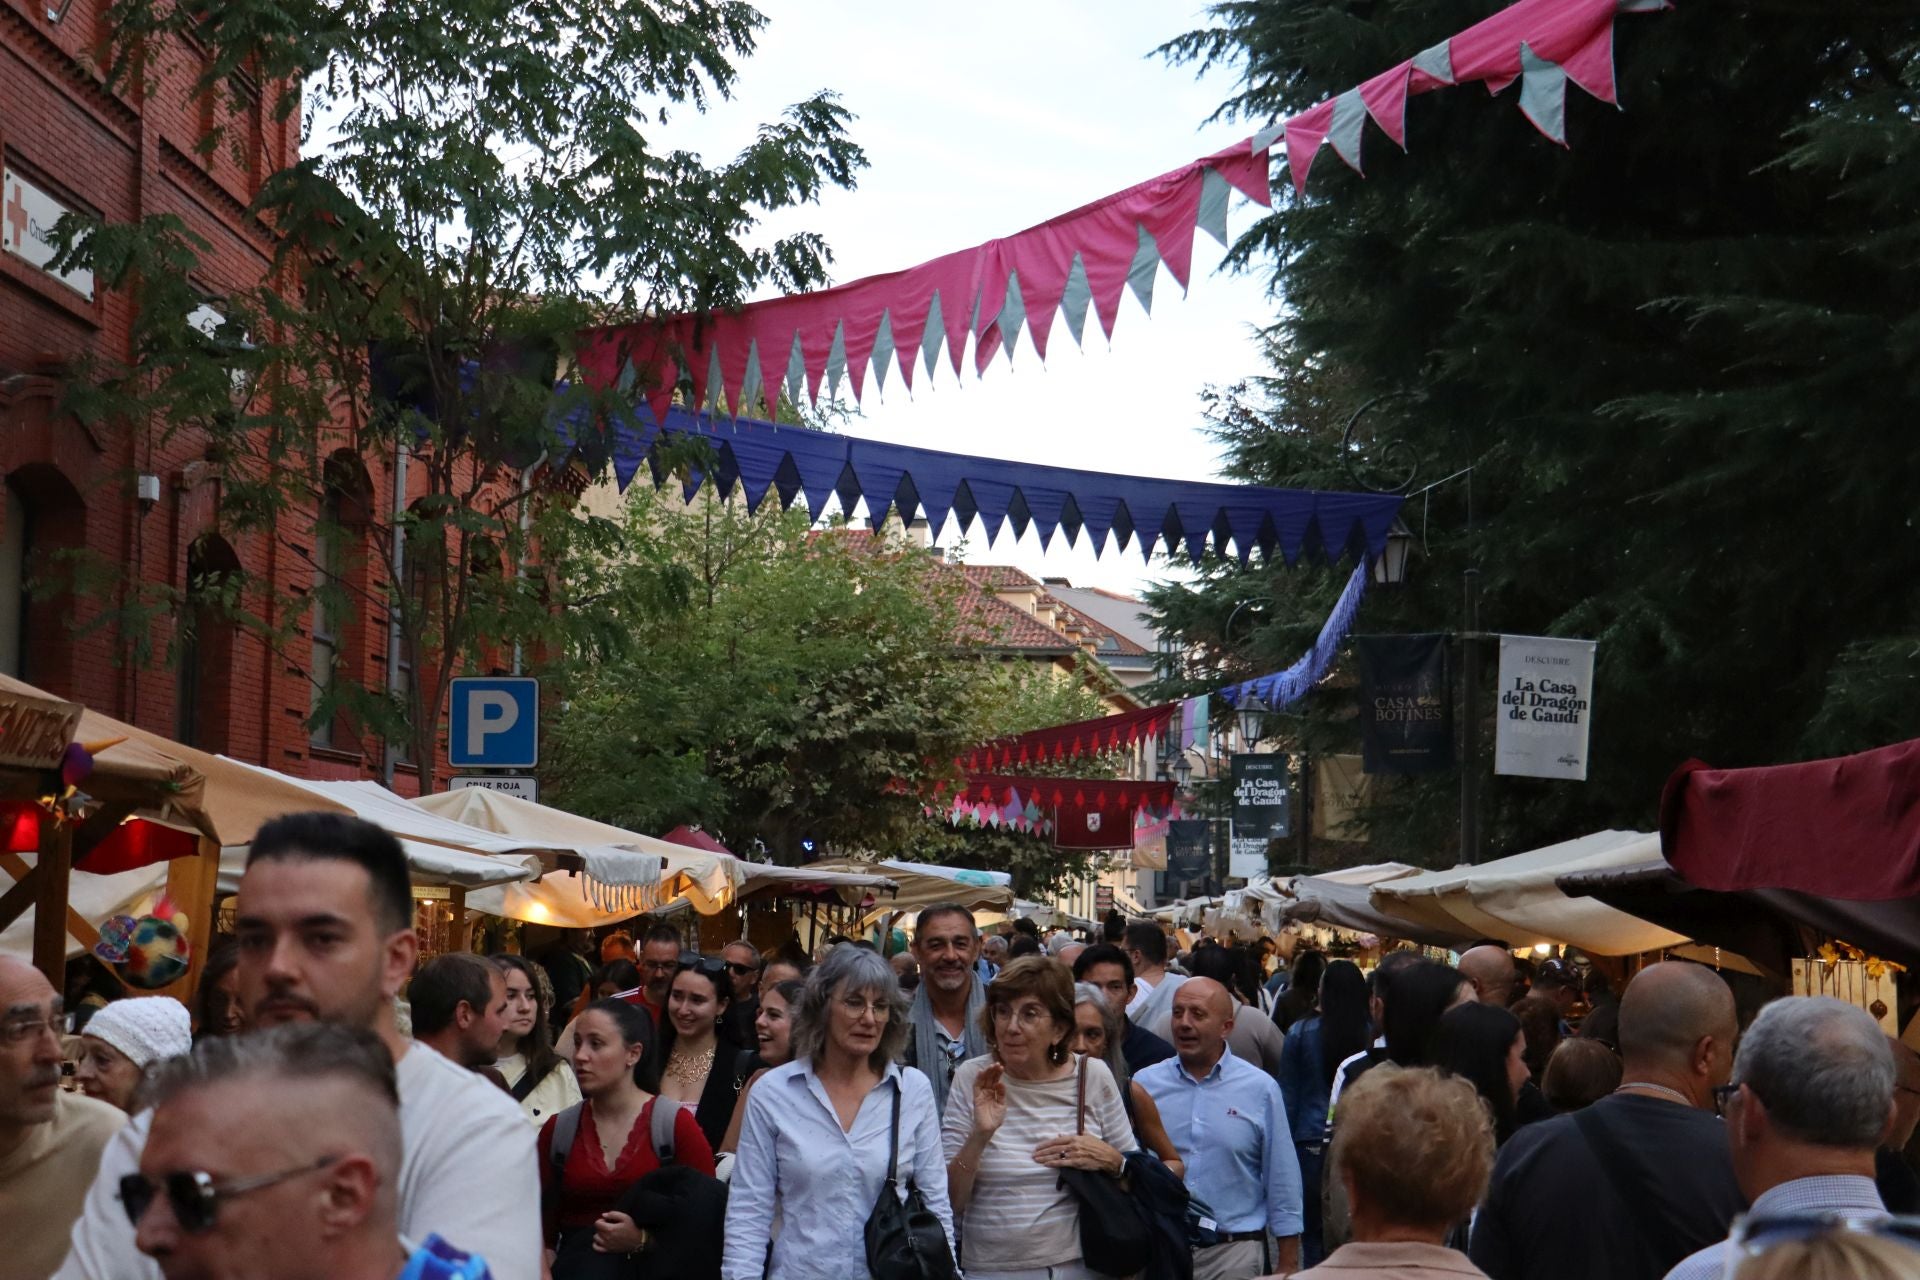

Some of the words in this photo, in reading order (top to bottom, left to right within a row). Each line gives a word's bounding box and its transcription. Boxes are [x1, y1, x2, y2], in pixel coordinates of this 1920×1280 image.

[1525, 655, 1571, 666] DESCUBRE
[1515, 677, 1535, 692] La
[1539, 679, 1577, 694] Casa
[1375, 697, 1415, 709] CASA
[1502, 691, 1526, 706] del
[1529, 693, 1588, 712] Dragón
[1376, 708, 1442, 721] BOTINES
[1509, 706, 1527, 721] de
[1532, 708, 1579, 724] Gaudí
[468, 690, 519, 755] P
[496, 782, 520, 790] ROJA
[1240, 779, 1253, 788] La
[1255, 778, 1279, 788] Casa
[1233, 787, 1249, 797] del
[1250, 786, 1286, 798] Dragón
[1238, 796, 1250, 806] de
[1252, 796, 1282, 806] Gaudí
